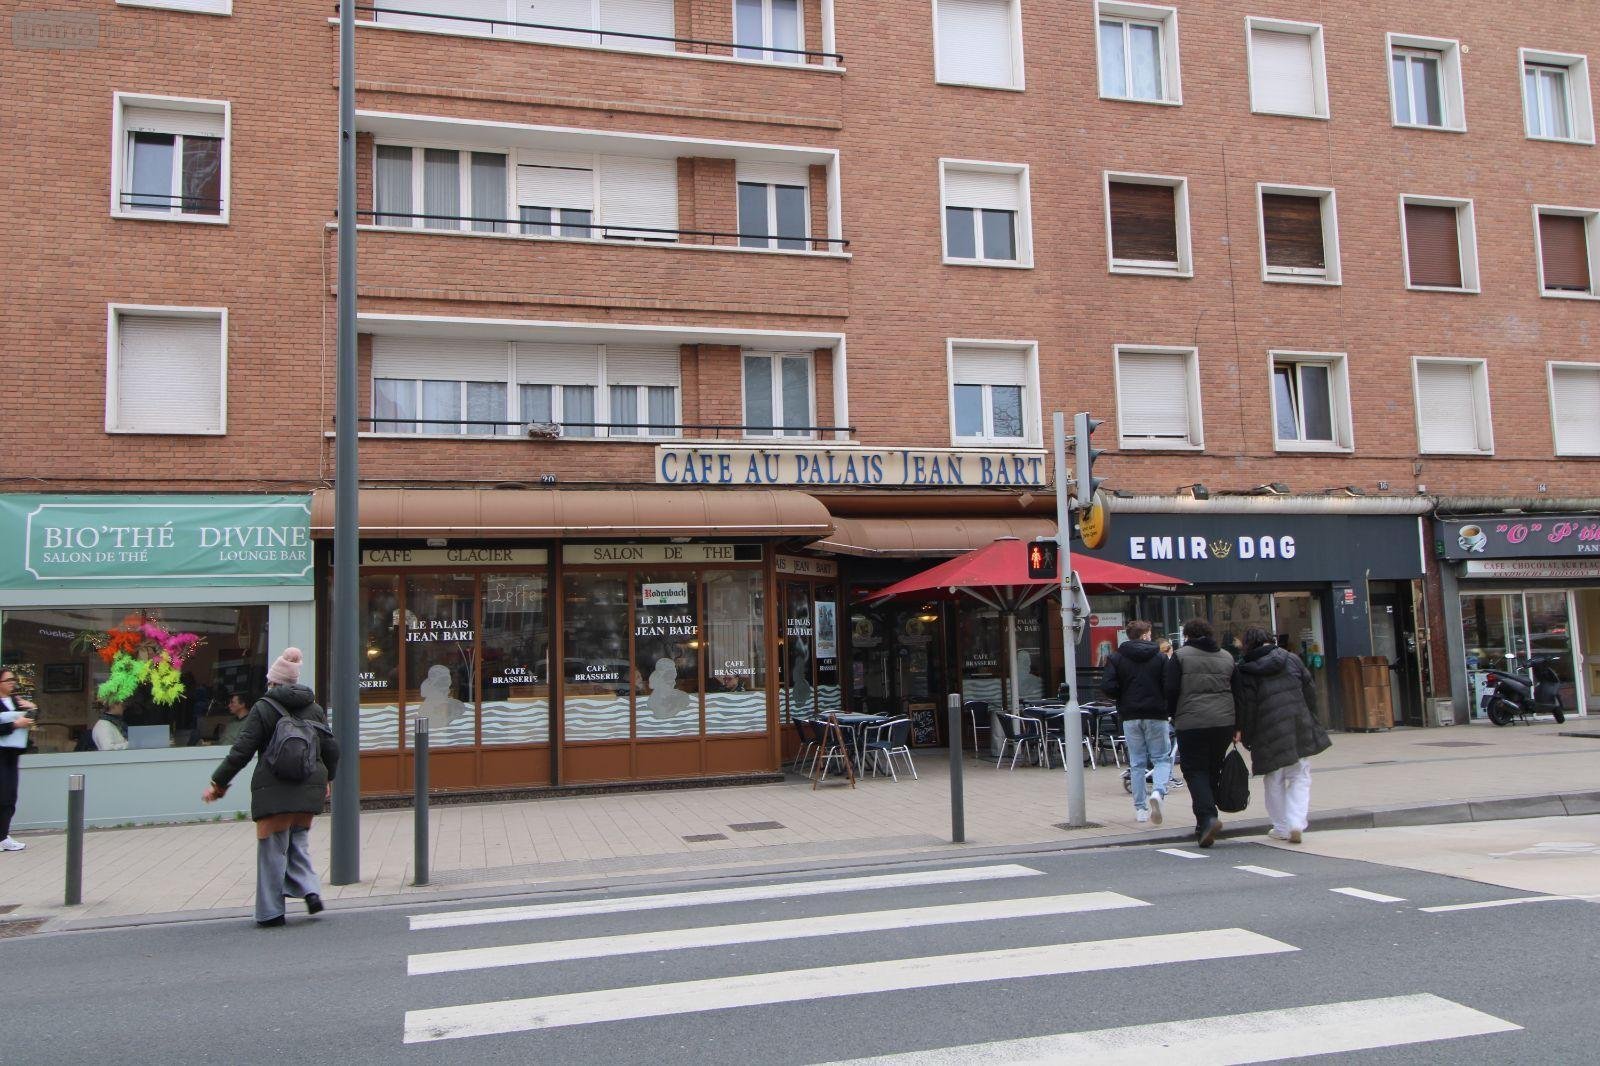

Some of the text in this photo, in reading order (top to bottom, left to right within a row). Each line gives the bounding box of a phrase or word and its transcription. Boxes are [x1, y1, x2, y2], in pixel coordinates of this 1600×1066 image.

[660, 450, 1043, 486] CAFE AU PALAIS JEAN BART
[43, 520, 308, 549] BIO'THÉ DIVINE
[593, 546, 733, 560] SALON DE THE
[1129, 535, 1297, 560] EMIR DAG
[1577, 544, 1600, 552] PAN
[43, 548, 148, 563] SALON DE THÉ
[219, 550, 307, 561] LOUNGE BAR
[369, 549, 514, 562] CAFE GLACIER
[644, 588, 687, 600] Rodenbach
[412, 619, 469, 630] LE PALAIS
[640, 615, 693, 625] LE PALAIS
[406, 630, 475, 642] JEAN BART
[634, 626, 699, 636] JEAN BART
[504, 667, 526, 675] CAFE
[586, 664, 608, 672] CAFE
[714, 667, 756, 676] BRASSERIE
[358, 672, 376, 680] AFE
[492, 675, 539, 684] BRASSERIE
[575, 672, 620, 681] BRASSERIE
